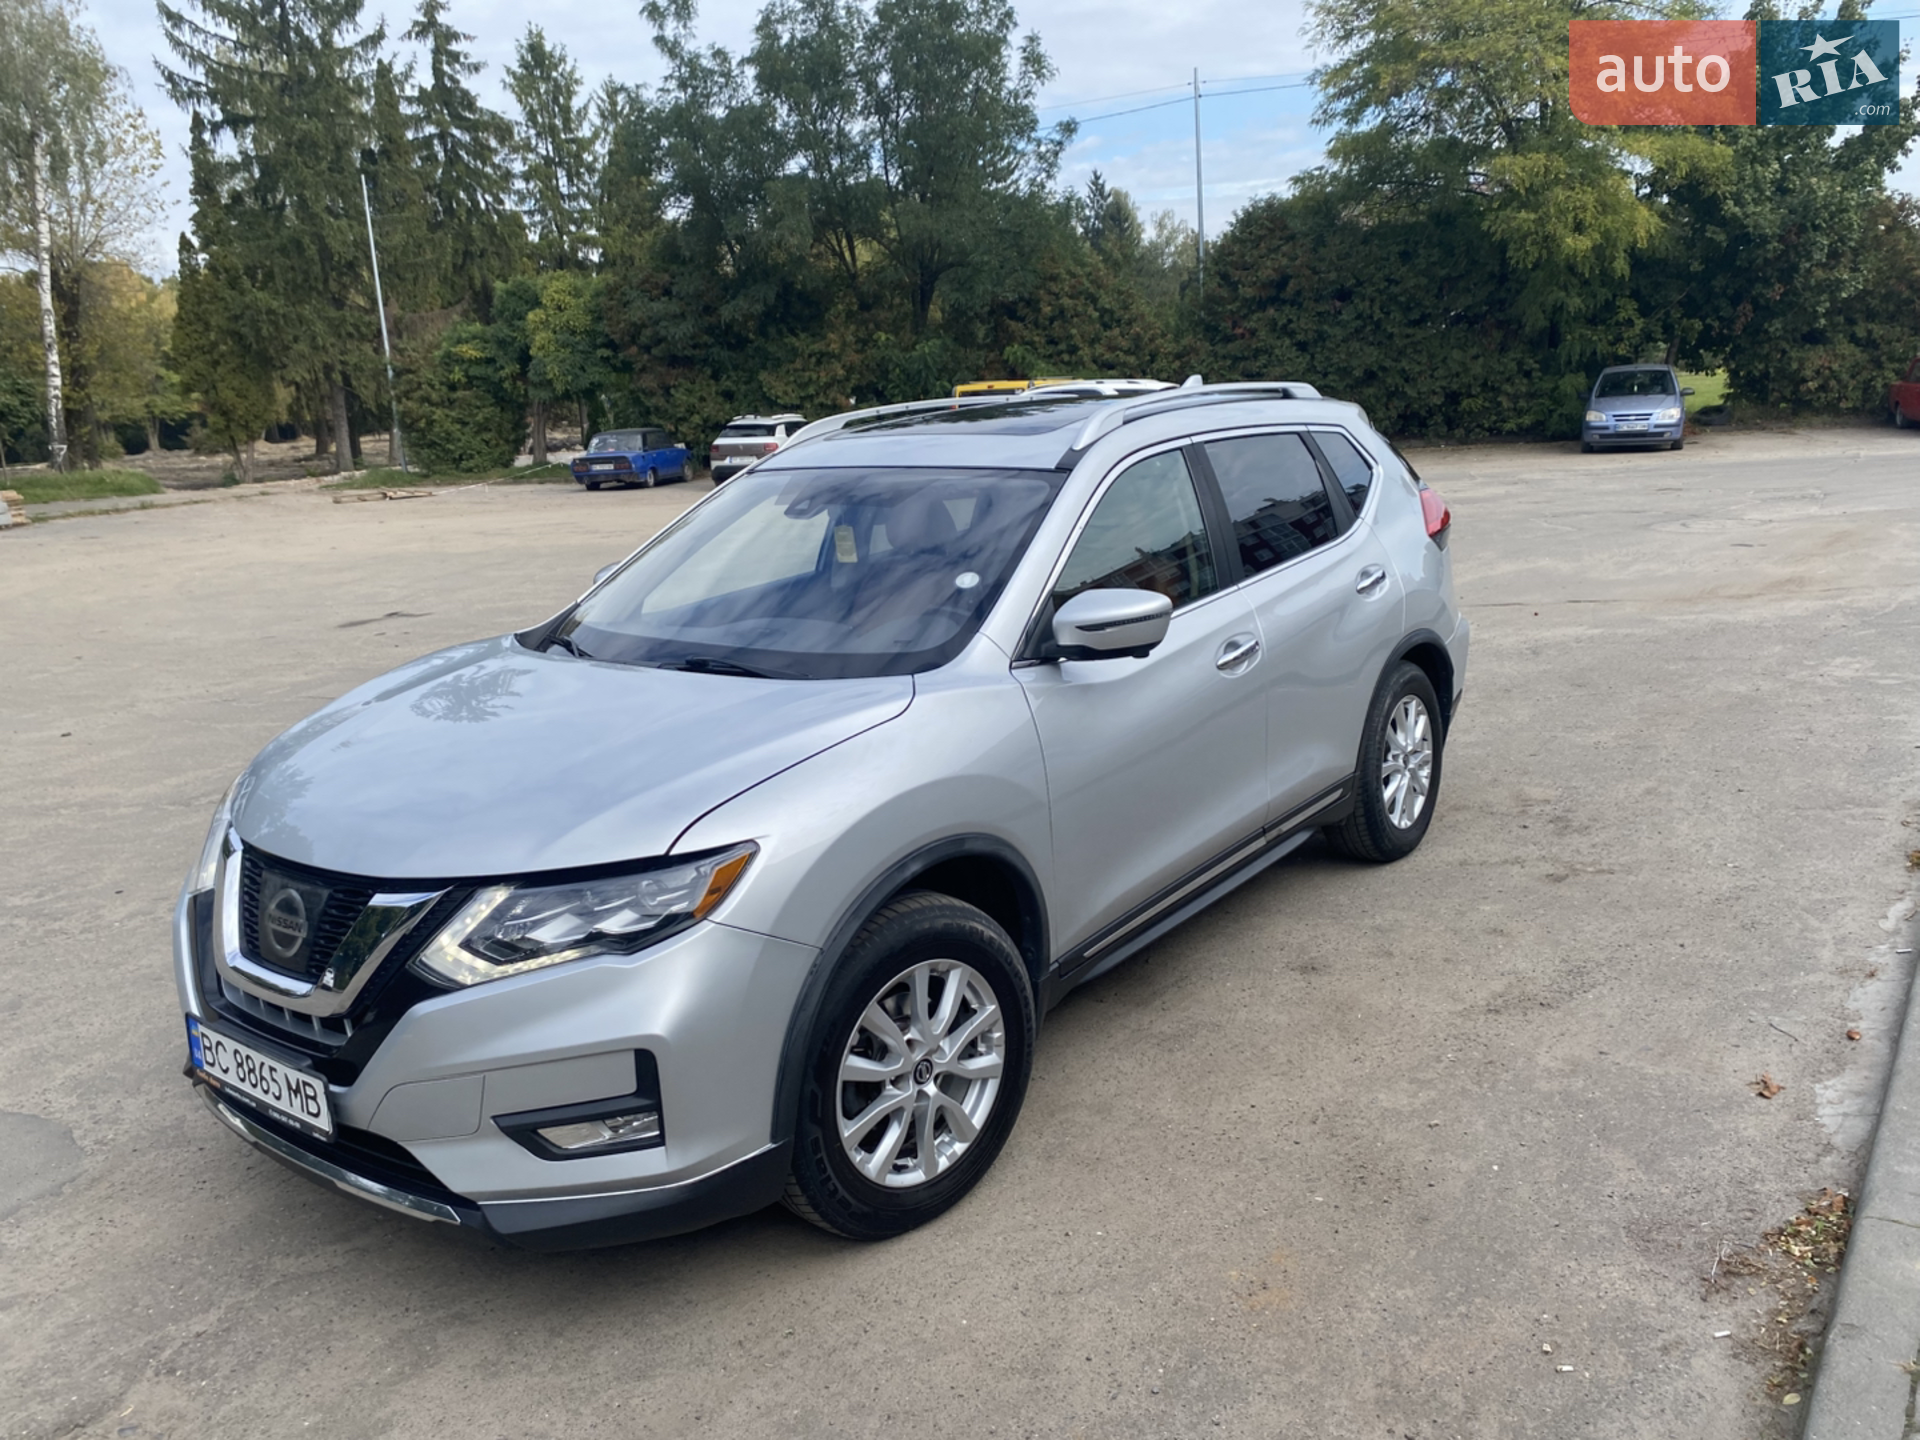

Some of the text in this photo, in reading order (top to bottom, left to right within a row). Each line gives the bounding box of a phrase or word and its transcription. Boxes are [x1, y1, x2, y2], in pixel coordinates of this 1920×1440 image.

[268, 913, 302, 933] NISSAN
[201, 1033, 229, 1074] BC
[233, 1049, 282, 1101] 8865
[285, 1072, 320, 1118] MB
